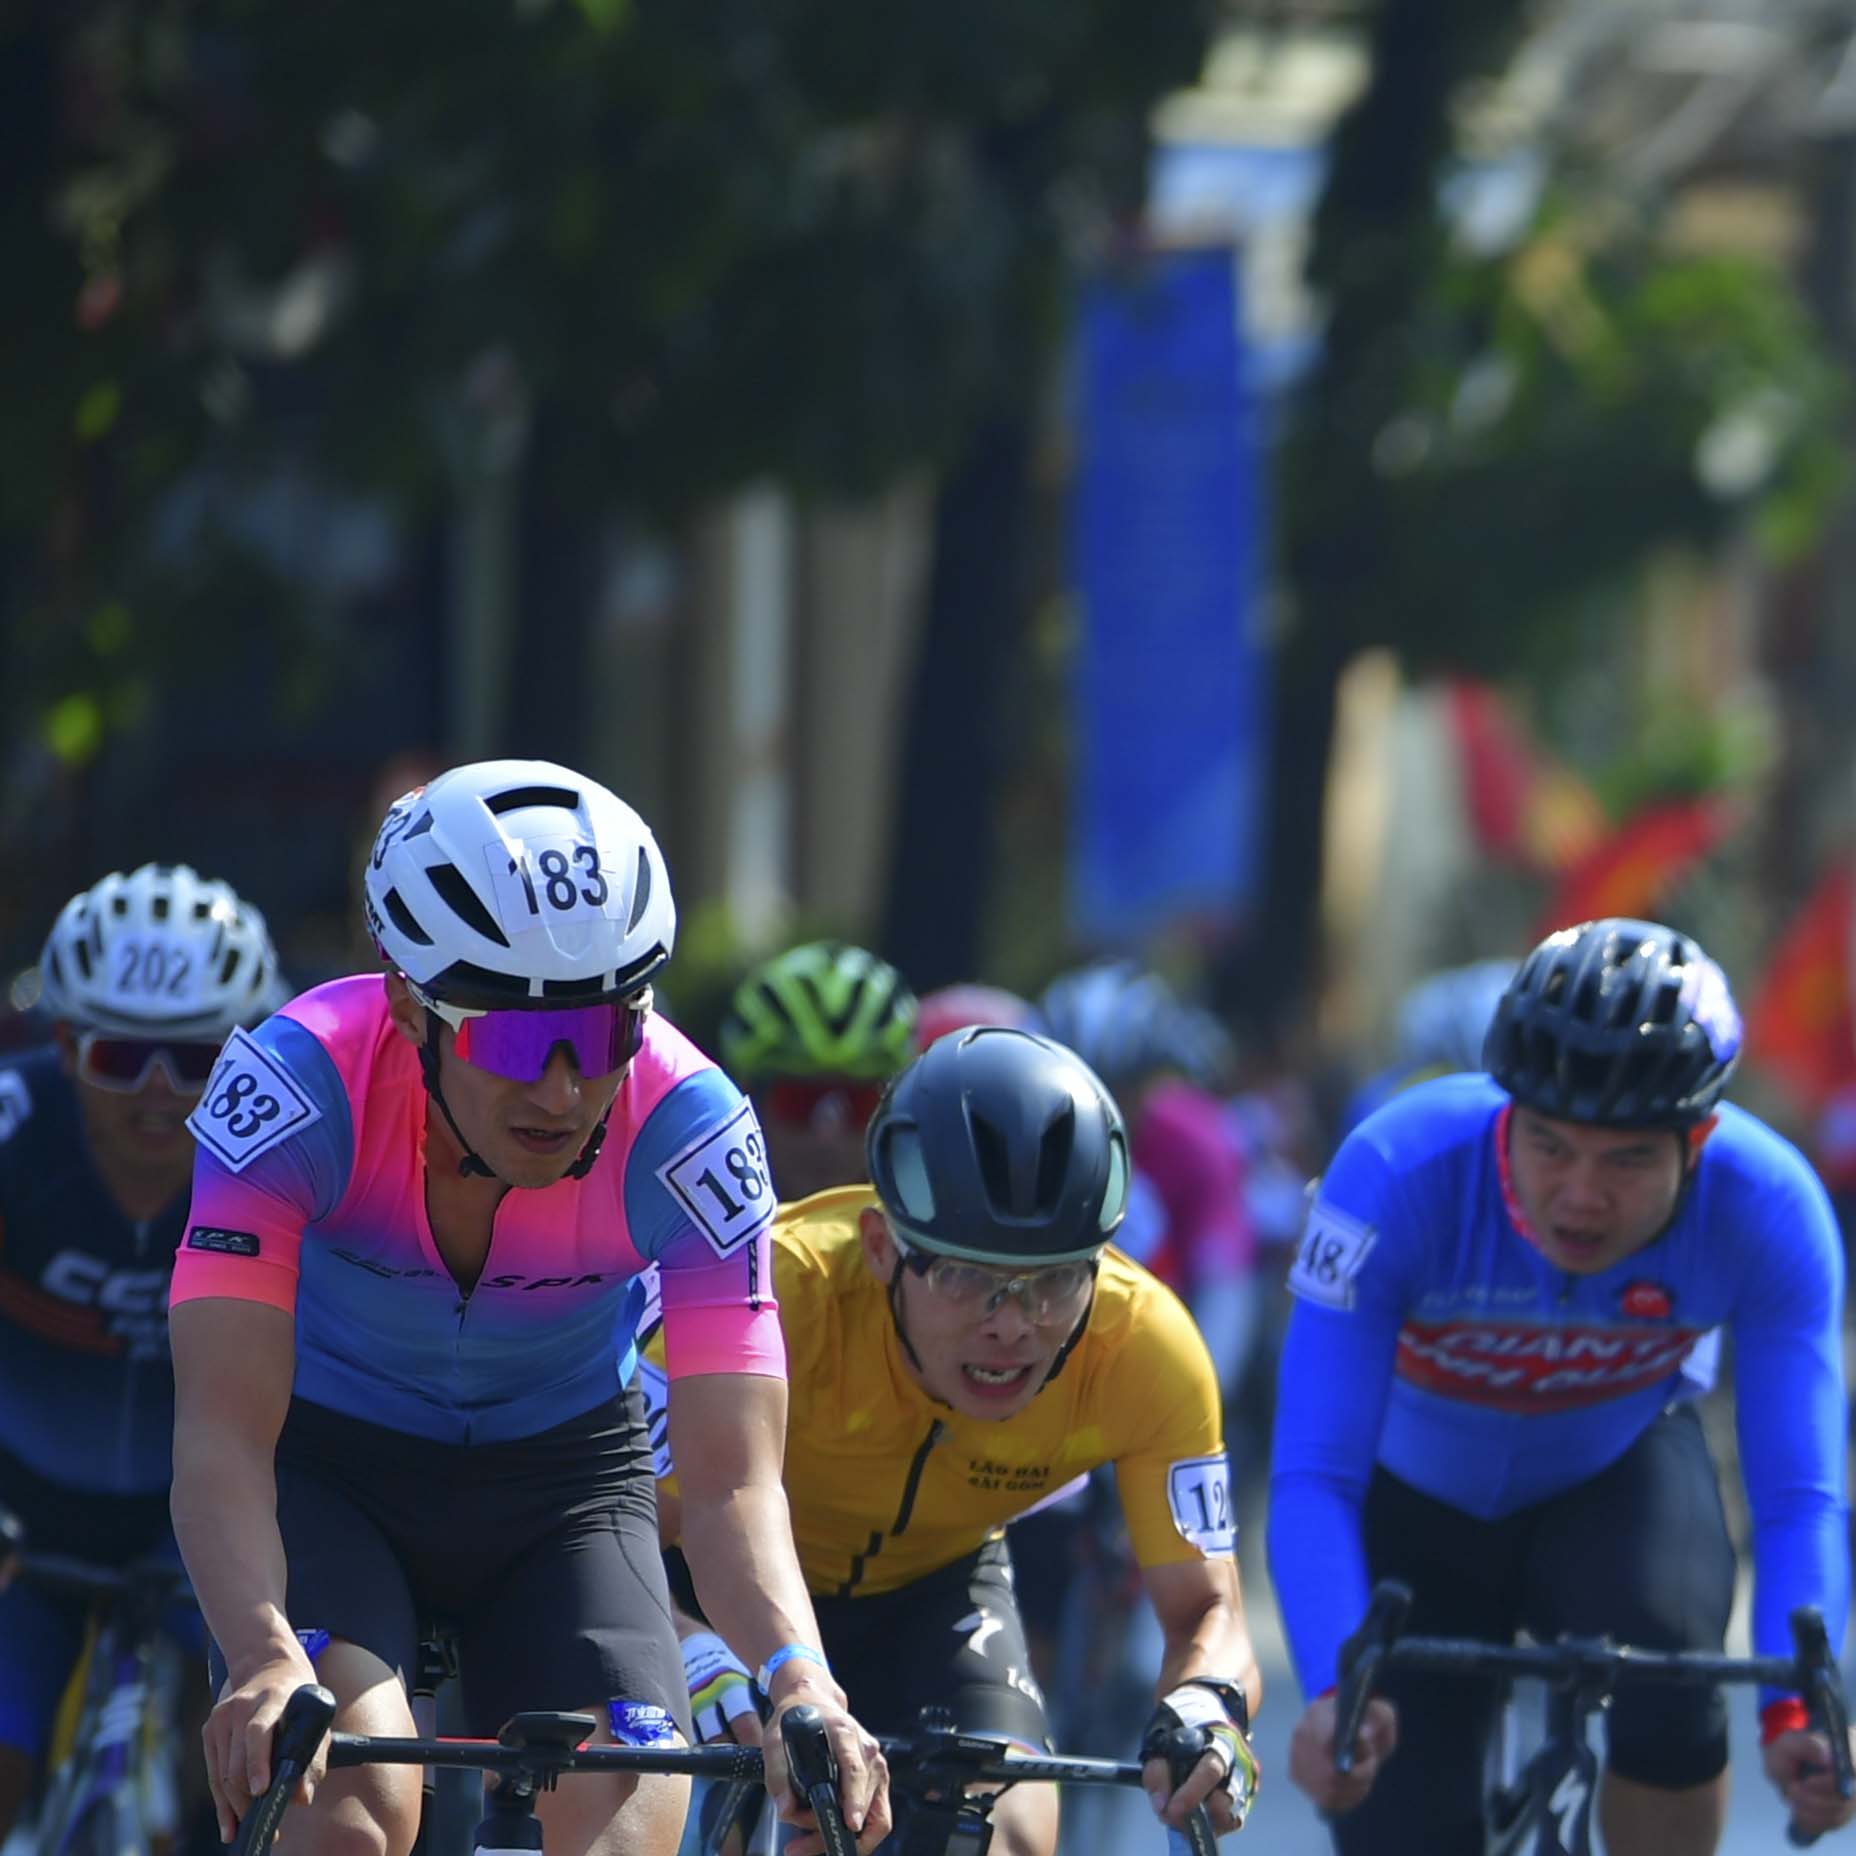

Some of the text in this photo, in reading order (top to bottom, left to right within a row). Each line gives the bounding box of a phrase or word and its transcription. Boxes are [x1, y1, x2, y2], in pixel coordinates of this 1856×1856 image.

[509, 846, 607, 915] 183
[117, 945, 190, 993] 202
[204, 1059, 281, 1139] 183
[42, 1250, 170, 1311] CC
